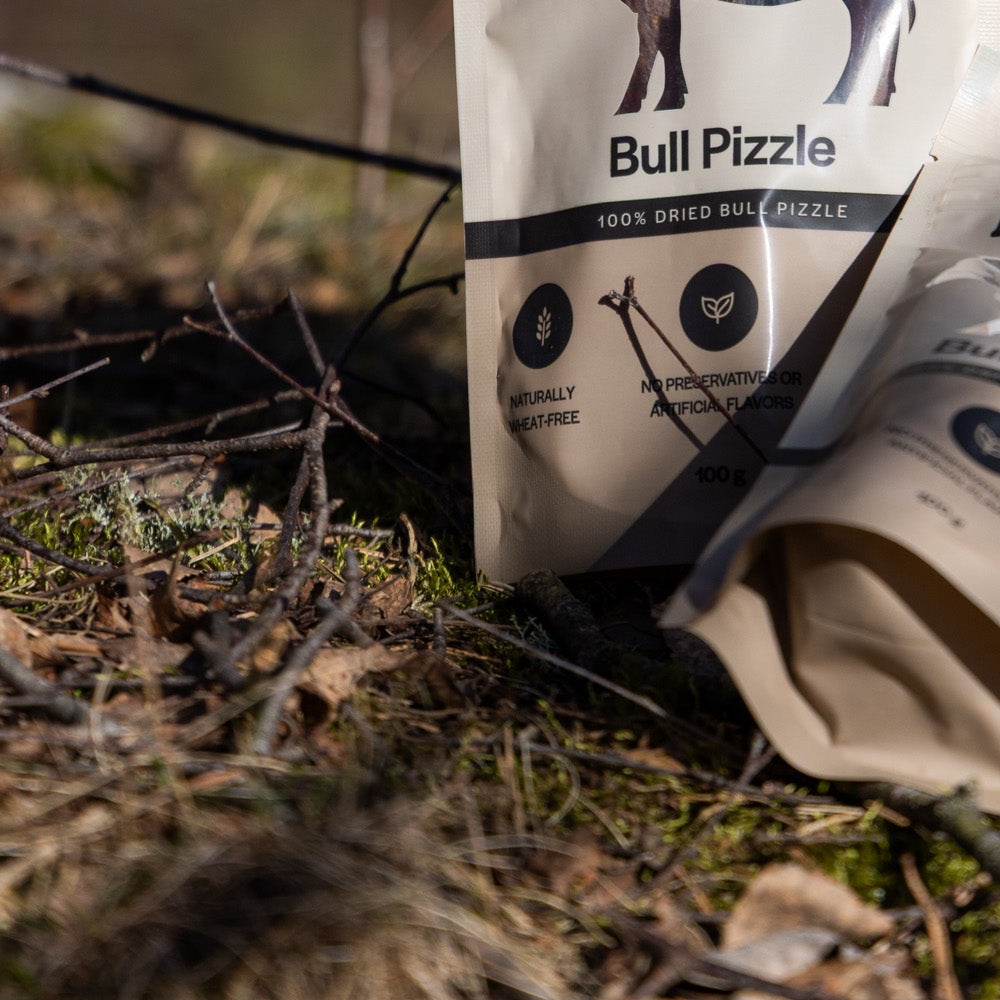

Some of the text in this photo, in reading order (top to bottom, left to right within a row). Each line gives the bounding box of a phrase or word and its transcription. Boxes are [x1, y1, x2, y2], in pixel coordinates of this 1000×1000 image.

[610, 124, 836, 178] Bull Pizzle
[597, 201, 848, 229] 100% DRIED BULL PIZZLE
[641, 371, 803, 393] NO PRESERVATIVES OR
[510, 385, 576, 410] NATURALLY
[726, 394, 795, 411] FLAVORS
[509, 410, 580, 434] WHEAT-FREE
